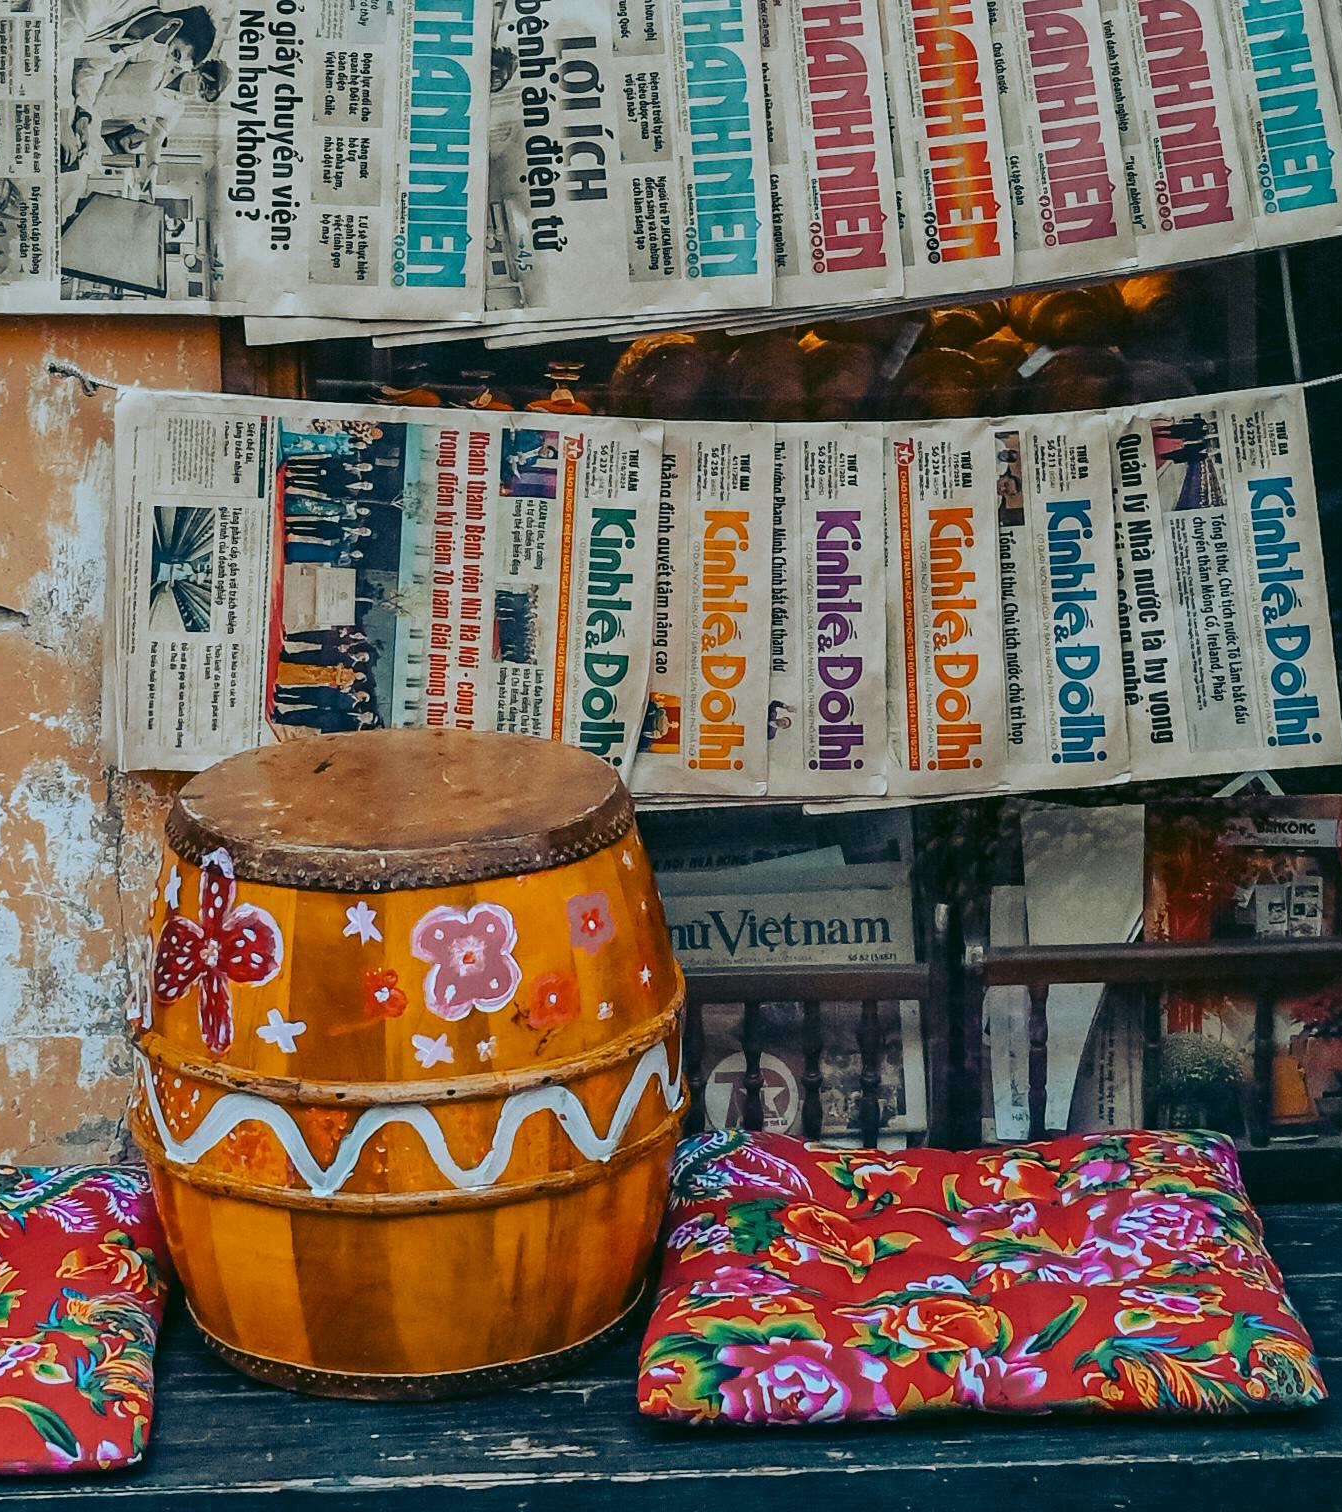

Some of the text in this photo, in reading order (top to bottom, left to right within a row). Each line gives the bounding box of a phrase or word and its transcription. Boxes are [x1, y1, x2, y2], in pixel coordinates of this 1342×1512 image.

[238, 9, 265, 60] Nên
[268, 21, 300, 77] giấy
[229, 67, 263, 114] hay
[521, 86, 556, 127] án
[266, 83, 301, 177] chuyển
[553, 36, 607, 201] LỢI ÍCH
[227, 120, 262, 201] không
[525, 134, 563, 208] điện
[264, 184, 292, 250] viện:
[531, 215, 567, 252] tử
[434, 430, 459, 467] trọng
[467, 431, 489, 475] Khánh
[436, 472, 458, 506] điểm
[465, 480, 487, 520] thành
[433, 510, 456, 526] kỷ
[430, 530, 455, 564] niệm
[460, 524, 485, 559] Bệnh
[432, 569, 453, 585] 70
[458, 564, 483, 593] viện
[1118, 433, 1173, 743] Quản lý Nhà nước là hy vọng
[432, 588, 451, 618] năm
[460, 597, 481, 620] Nhi
[430, 622, 453, 649] Giải
[459, 623, 480, 641] Hà
[425, 653, 450, 696] phóng
[458, 645, 479, 668] Nội
[453, 681, 477, 715] công
